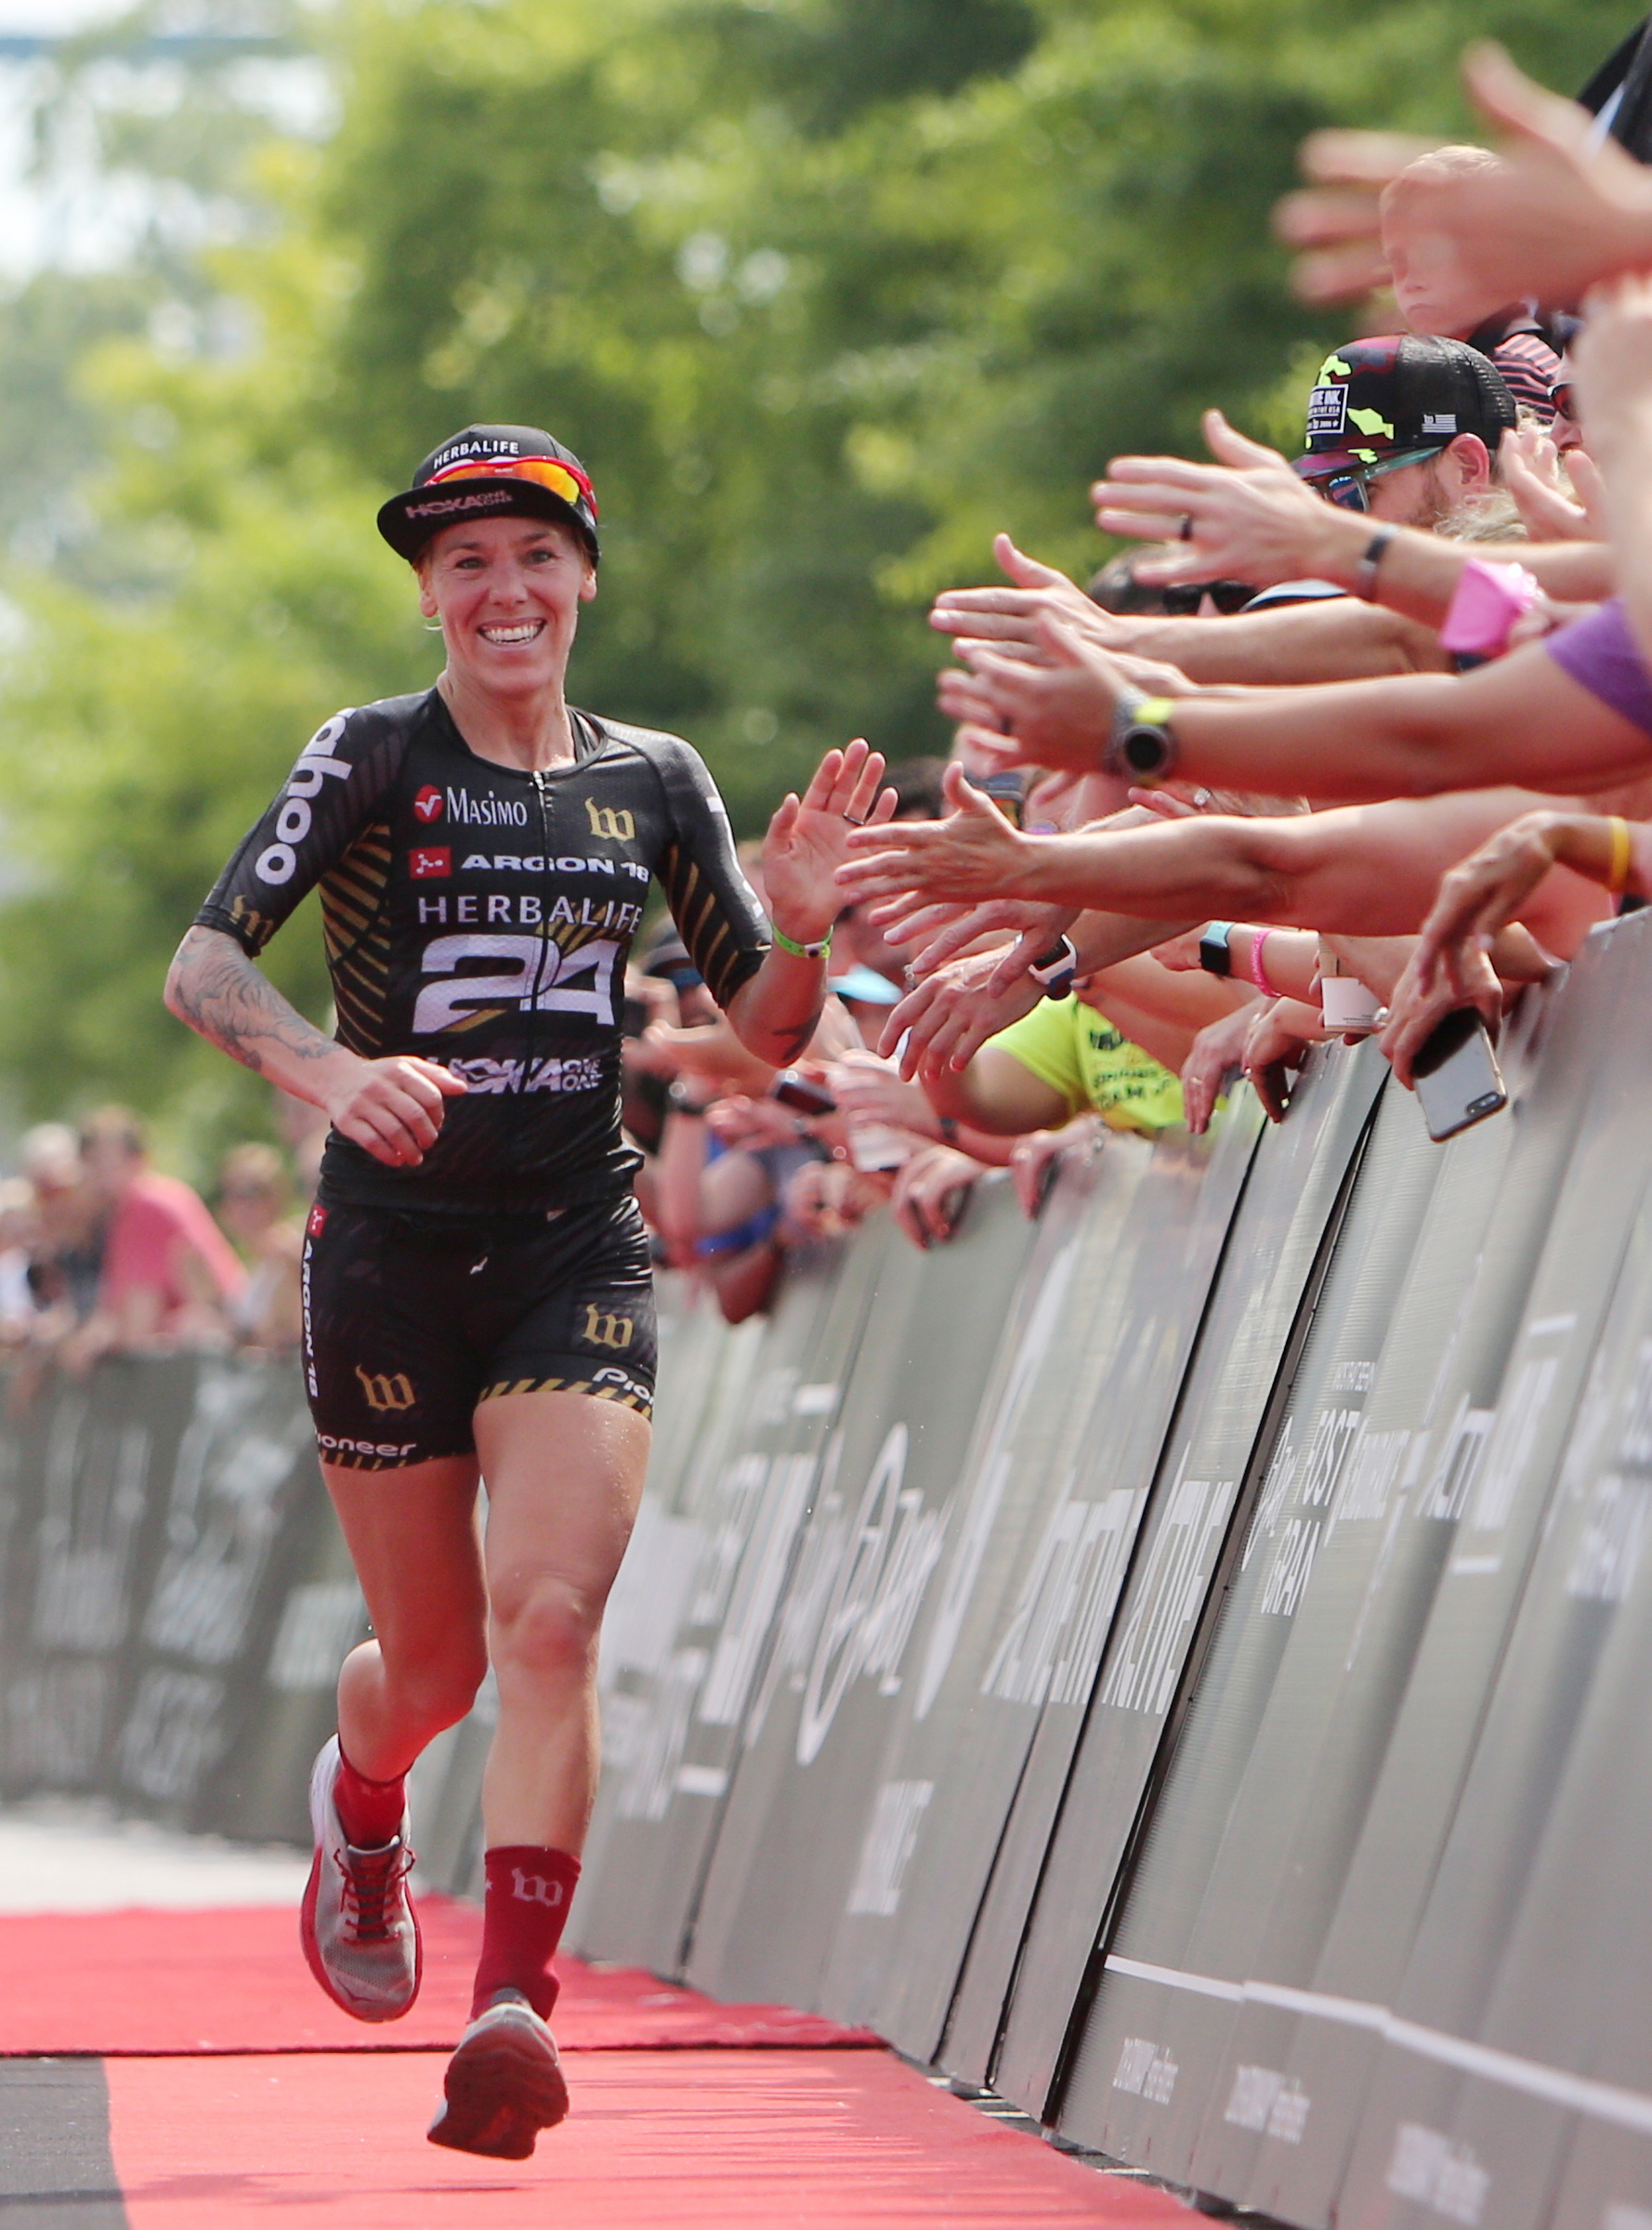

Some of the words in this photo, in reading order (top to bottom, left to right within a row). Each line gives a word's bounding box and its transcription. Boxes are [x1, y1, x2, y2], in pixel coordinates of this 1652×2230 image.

[433, 440, 519, 469] HERBALIFE
[406, 496, 483, 518] HOKA
[255, 707, 358, 885] ahoo
[461, 854, 615, 874] ARGON
[621, 862, 649, 883] 18
[418, 895, 643, 934] HERBALIFE
[413, 933, 622, 1033] 24
[315, 1427, 417, 1457] ioneer
